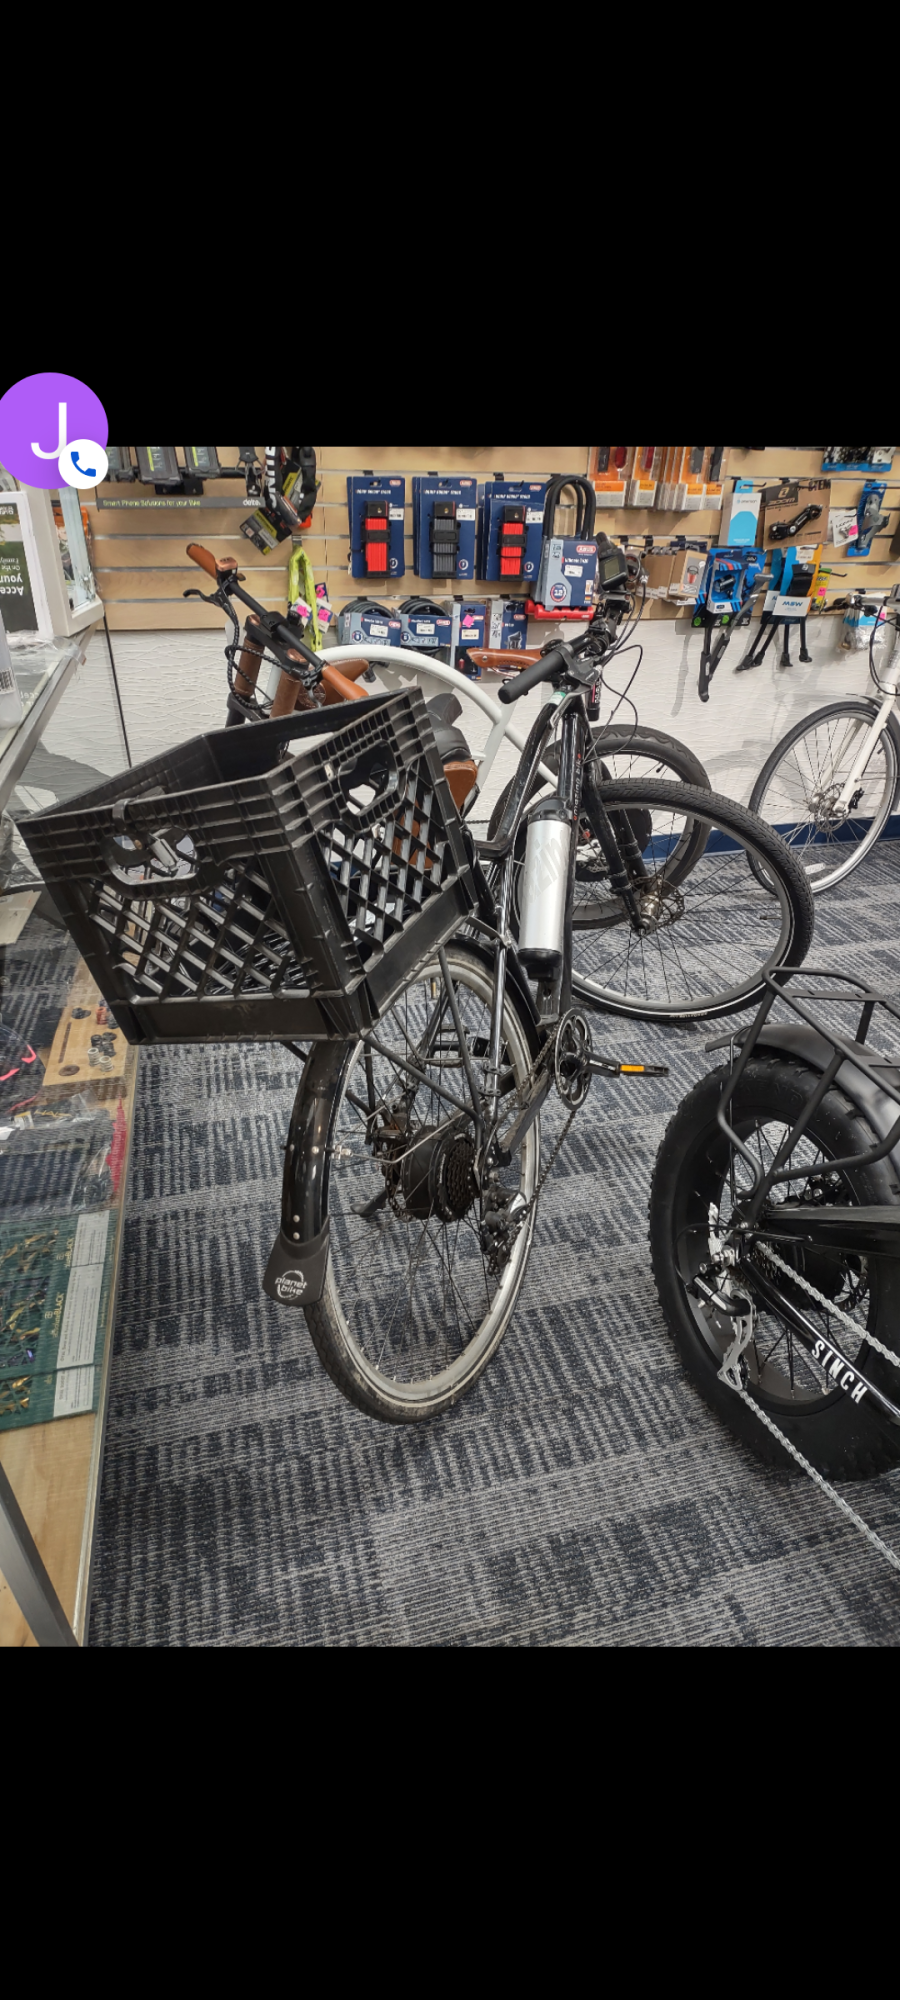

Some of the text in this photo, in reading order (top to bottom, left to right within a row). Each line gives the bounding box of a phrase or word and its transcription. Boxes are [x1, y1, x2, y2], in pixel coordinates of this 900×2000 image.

[275, 1277, 308, 1289] planet
[280, 1285, 304, 1296] bike
[811, 1338, 869, 1405] SINCH
